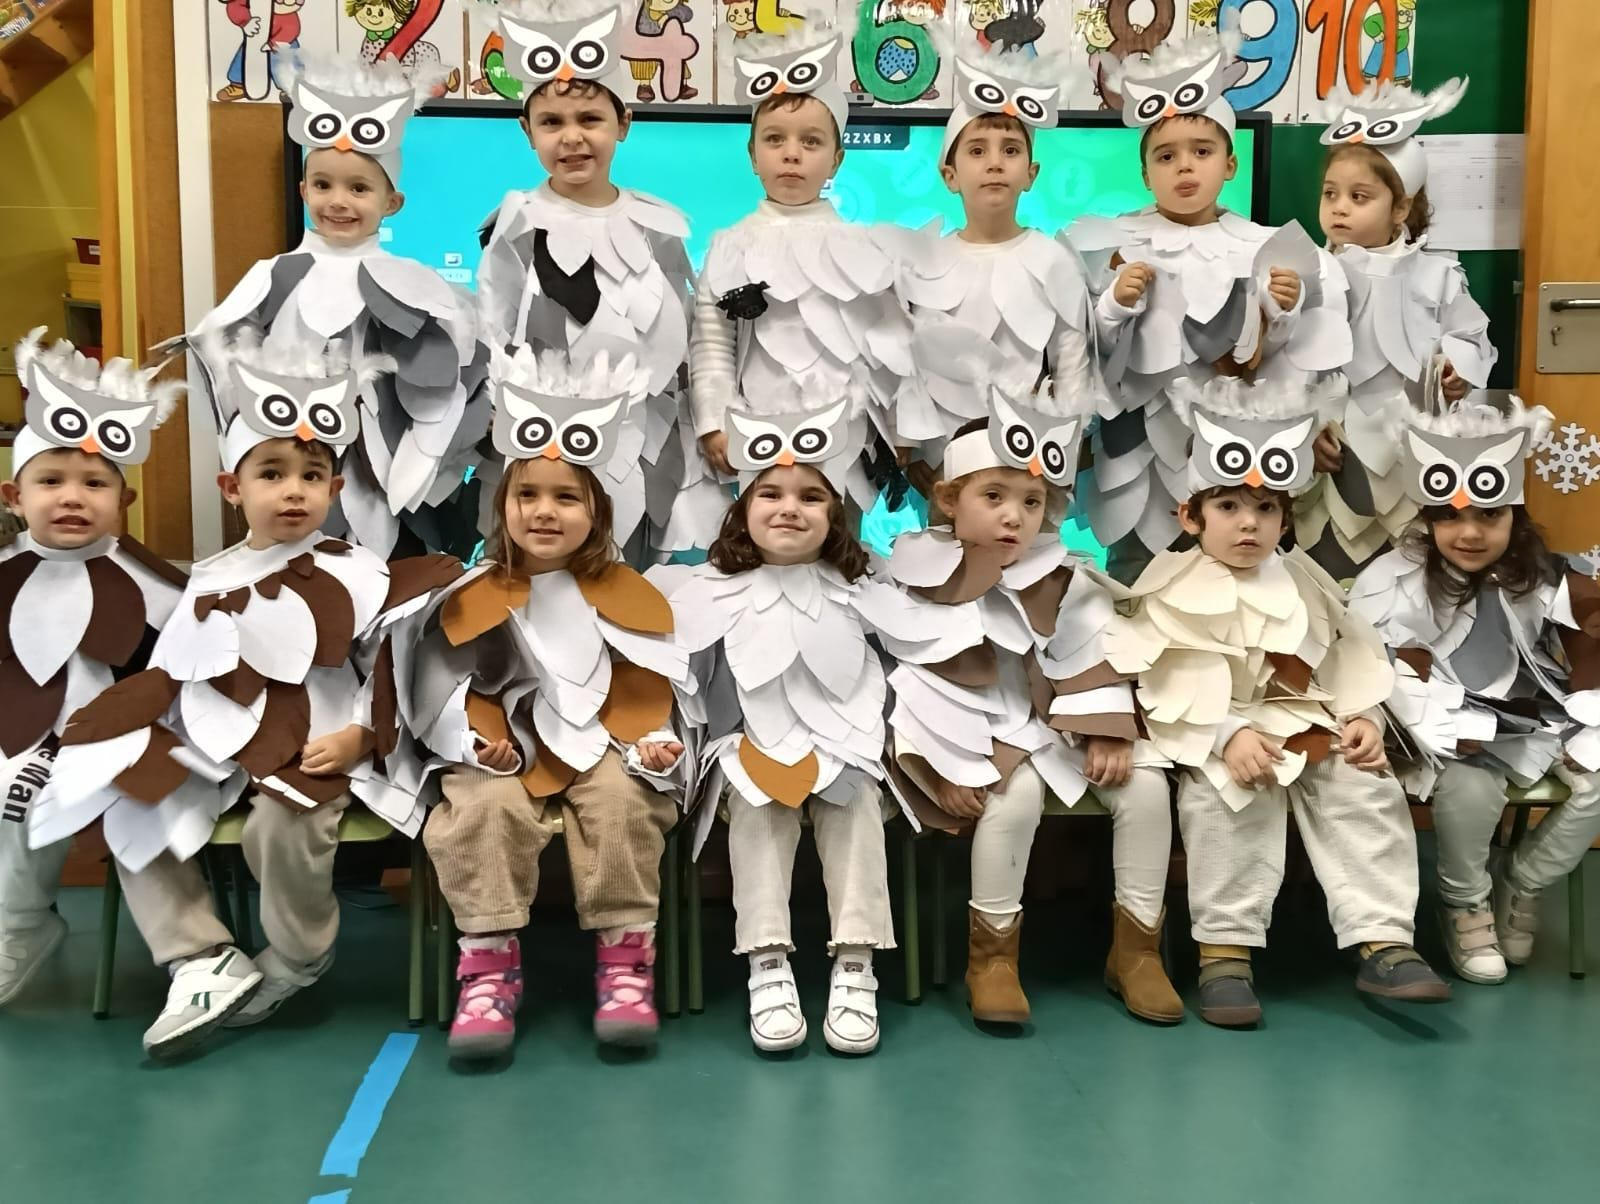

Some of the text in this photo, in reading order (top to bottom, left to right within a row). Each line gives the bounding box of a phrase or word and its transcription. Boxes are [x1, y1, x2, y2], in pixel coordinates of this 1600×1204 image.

[851, 0, 941, 105] 6
[1216, 0, 1300, 112] 9
[1305, 0, 1398, 100] 10
[2, 762, 53, 824] Man
